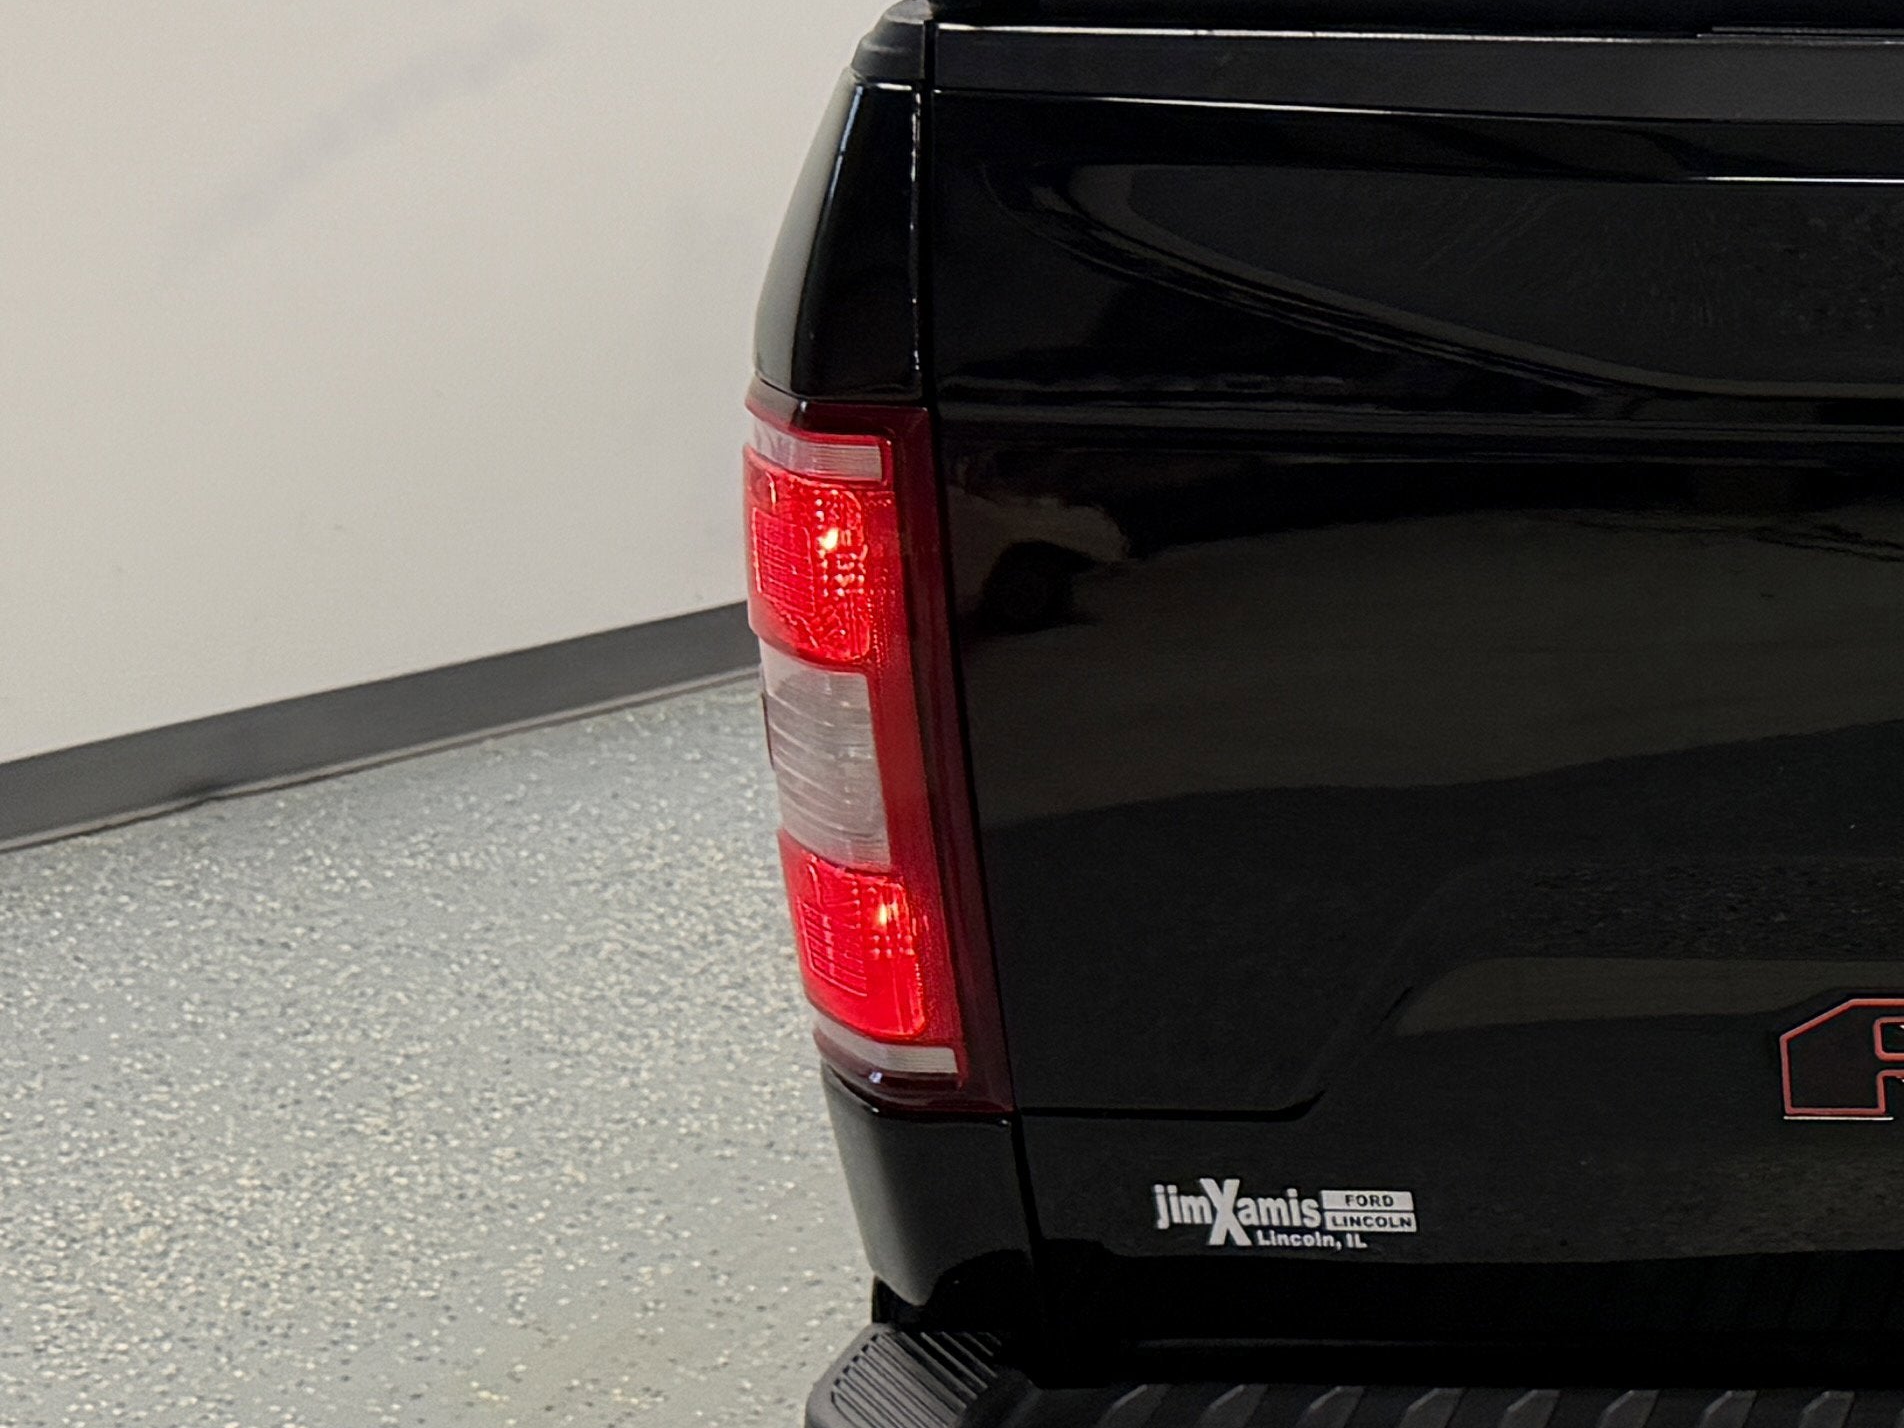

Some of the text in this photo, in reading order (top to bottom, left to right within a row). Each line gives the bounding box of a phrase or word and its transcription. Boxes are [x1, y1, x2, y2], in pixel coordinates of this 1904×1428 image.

[1345, 1195, 1395, 1207] FORD
[1331, 1216, 1412, 1229] LINCOLN
[1256, 1230, 1368, 1251] Lincoln, IL
